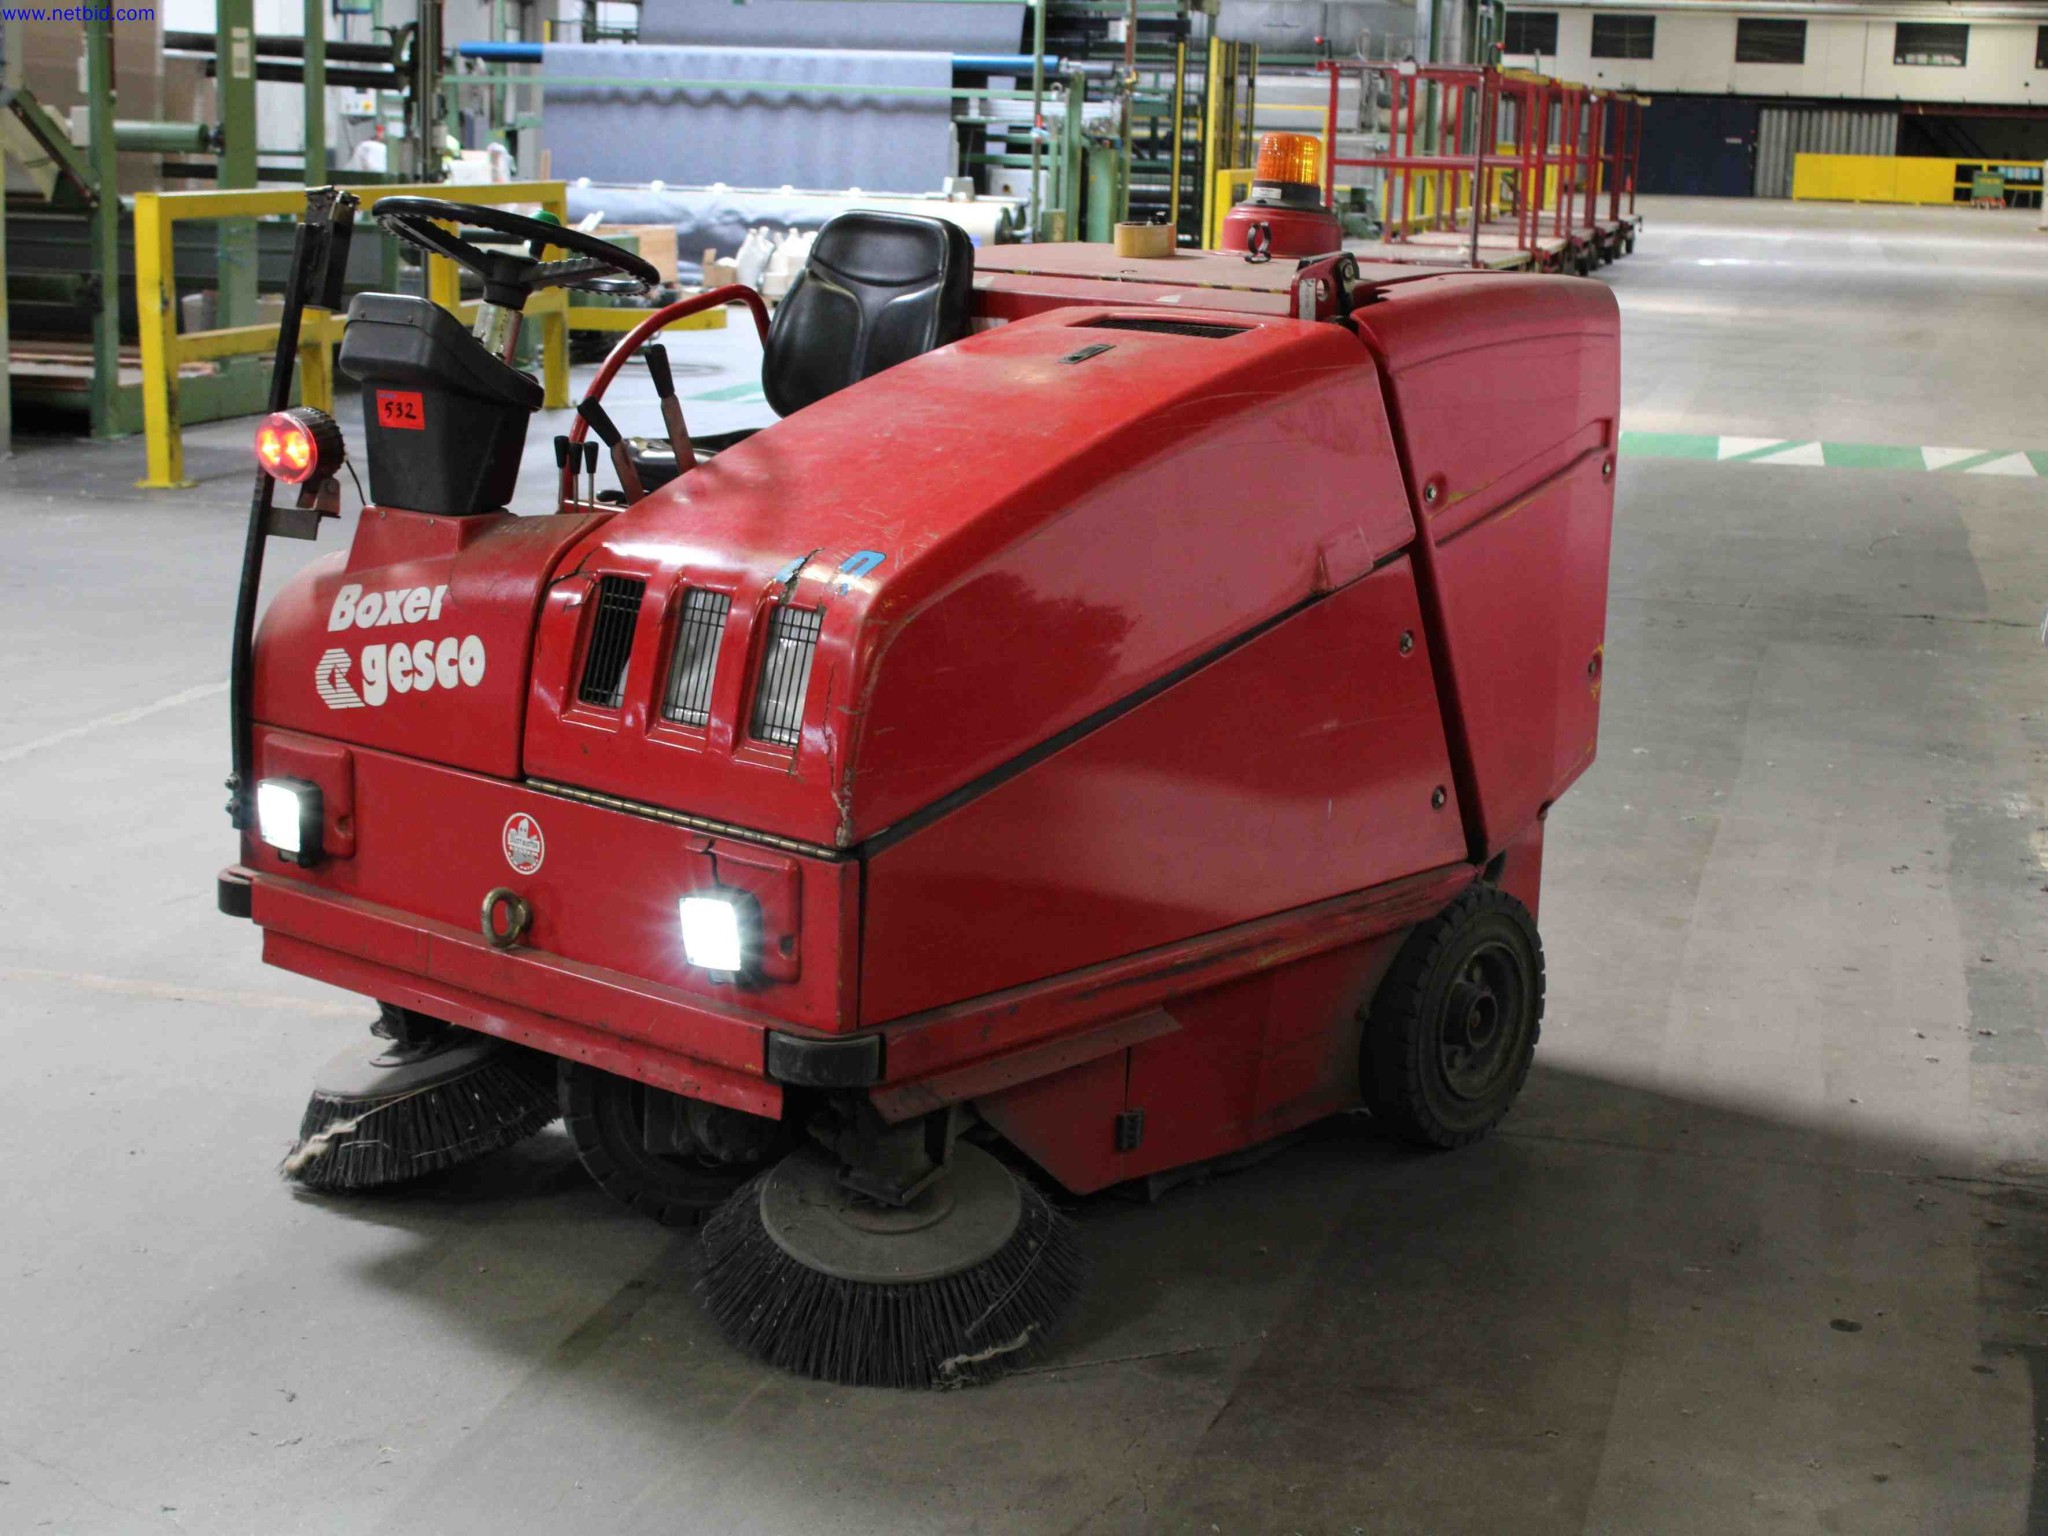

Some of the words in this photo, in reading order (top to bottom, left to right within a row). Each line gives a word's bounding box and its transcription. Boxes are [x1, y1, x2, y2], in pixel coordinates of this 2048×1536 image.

[384, 401, 417, 420] 532
[327, 583, 448, 632] Boxer
[361, 635, 486, 707] gesco
